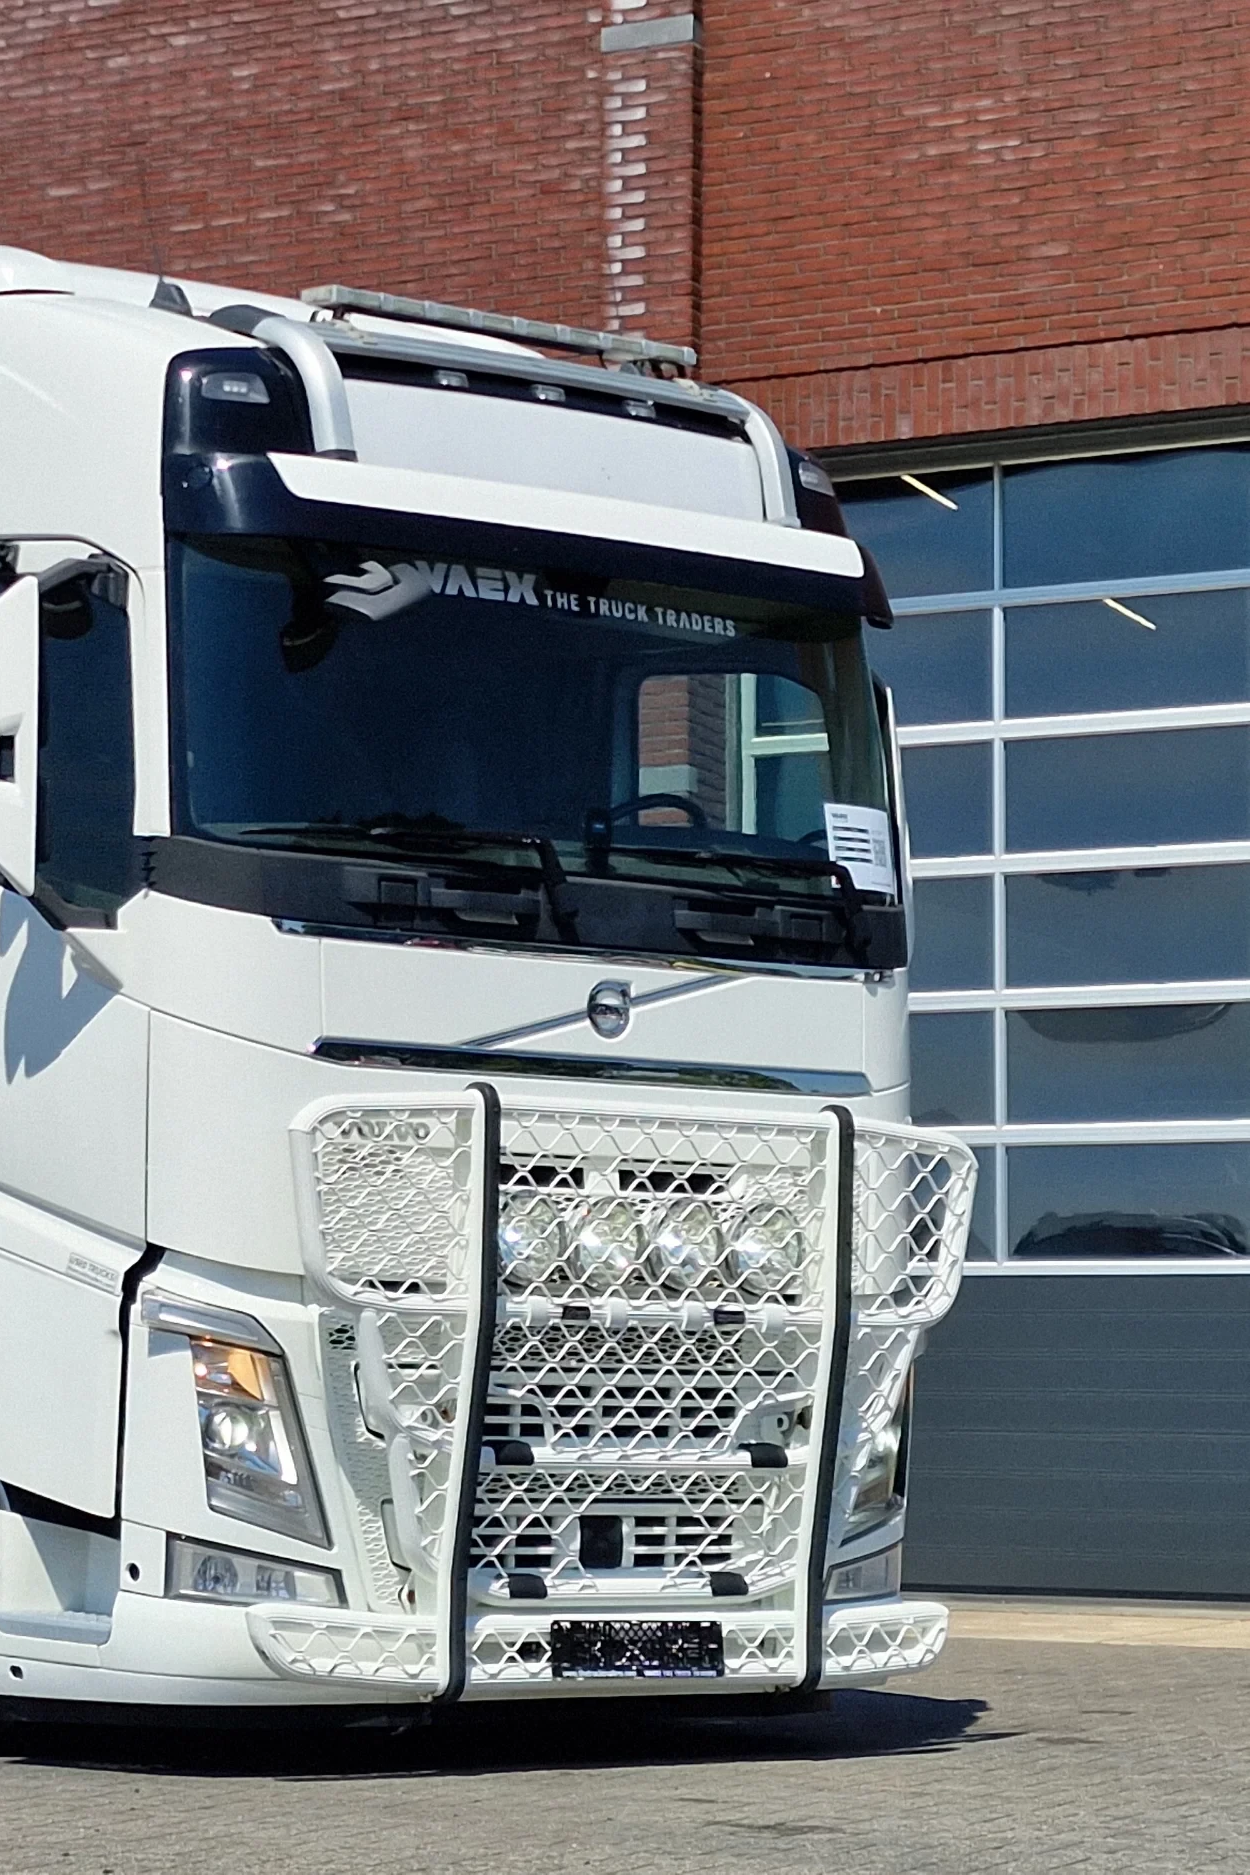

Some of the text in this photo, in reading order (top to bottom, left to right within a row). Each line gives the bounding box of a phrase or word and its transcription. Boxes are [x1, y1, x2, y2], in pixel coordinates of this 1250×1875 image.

[413, 560, 736, 637] VAEX THE TRUCK TRADERS
